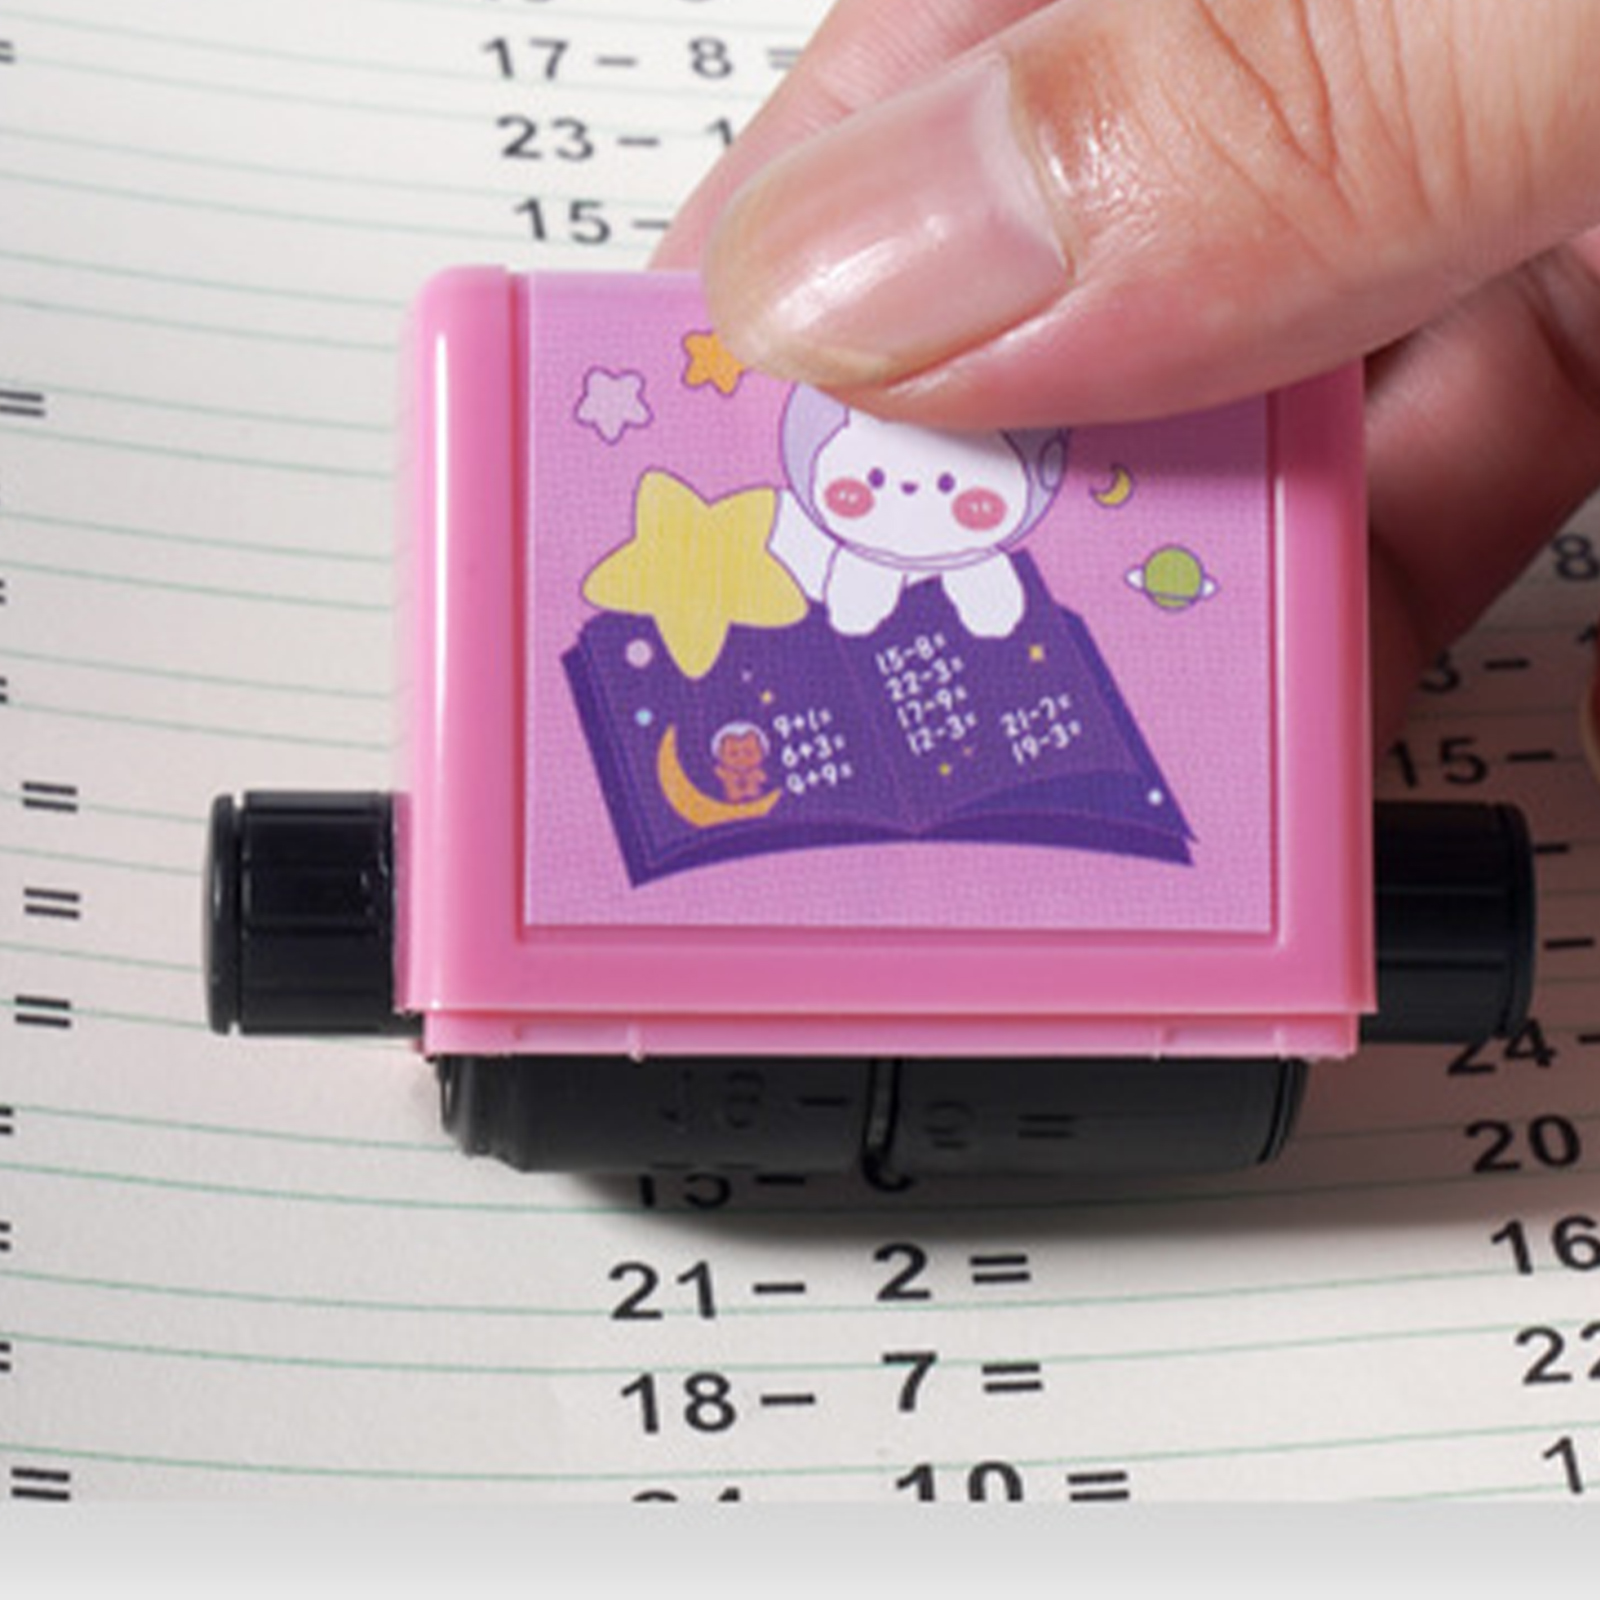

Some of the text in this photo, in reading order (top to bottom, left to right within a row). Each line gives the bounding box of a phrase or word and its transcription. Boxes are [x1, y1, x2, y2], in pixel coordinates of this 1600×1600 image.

[687, 36, 734, 79] 8
[1464, 1114, 1581, 1174] 20
[872, 1243, 932, 1301] 2
[883, 1352, 936, 1411] 7
